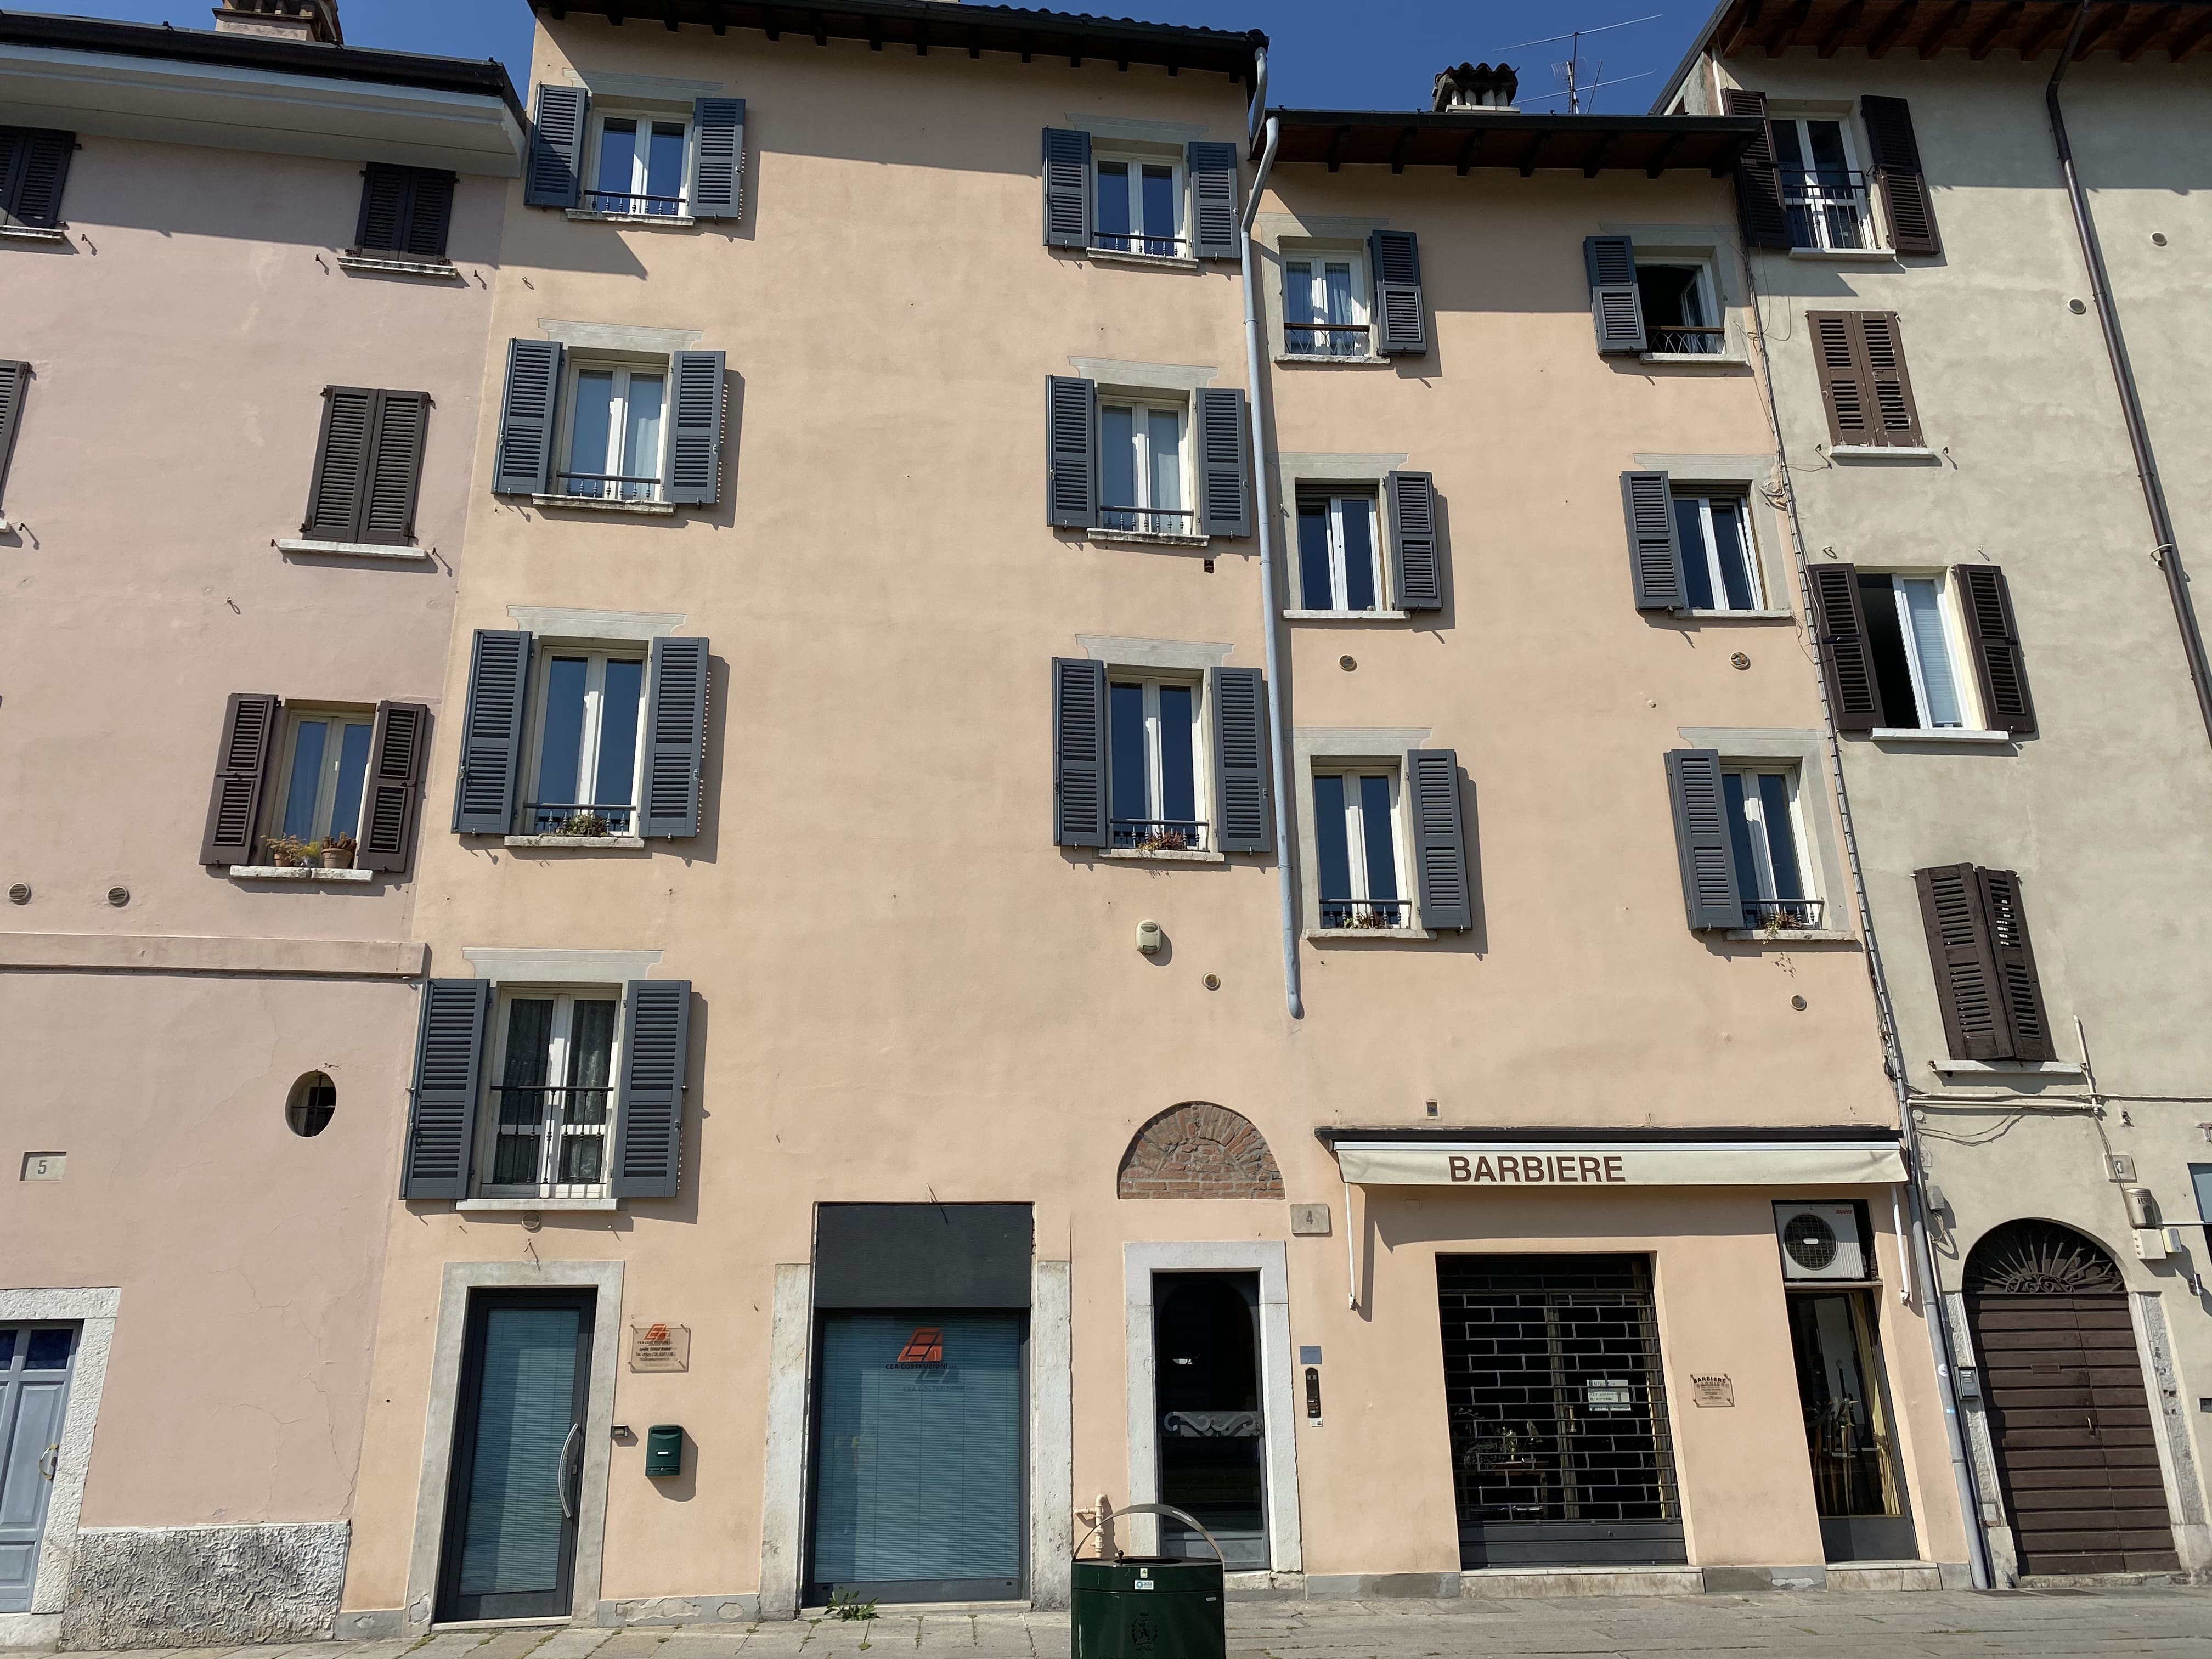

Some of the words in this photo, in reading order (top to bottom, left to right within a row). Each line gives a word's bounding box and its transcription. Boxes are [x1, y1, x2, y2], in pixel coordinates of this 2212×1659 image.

[37, 1160, 47, 1175] 5
[1448, 1156, 1626, 1182] BARBIERE
[1306, 1210, 1313, 1225] 4
